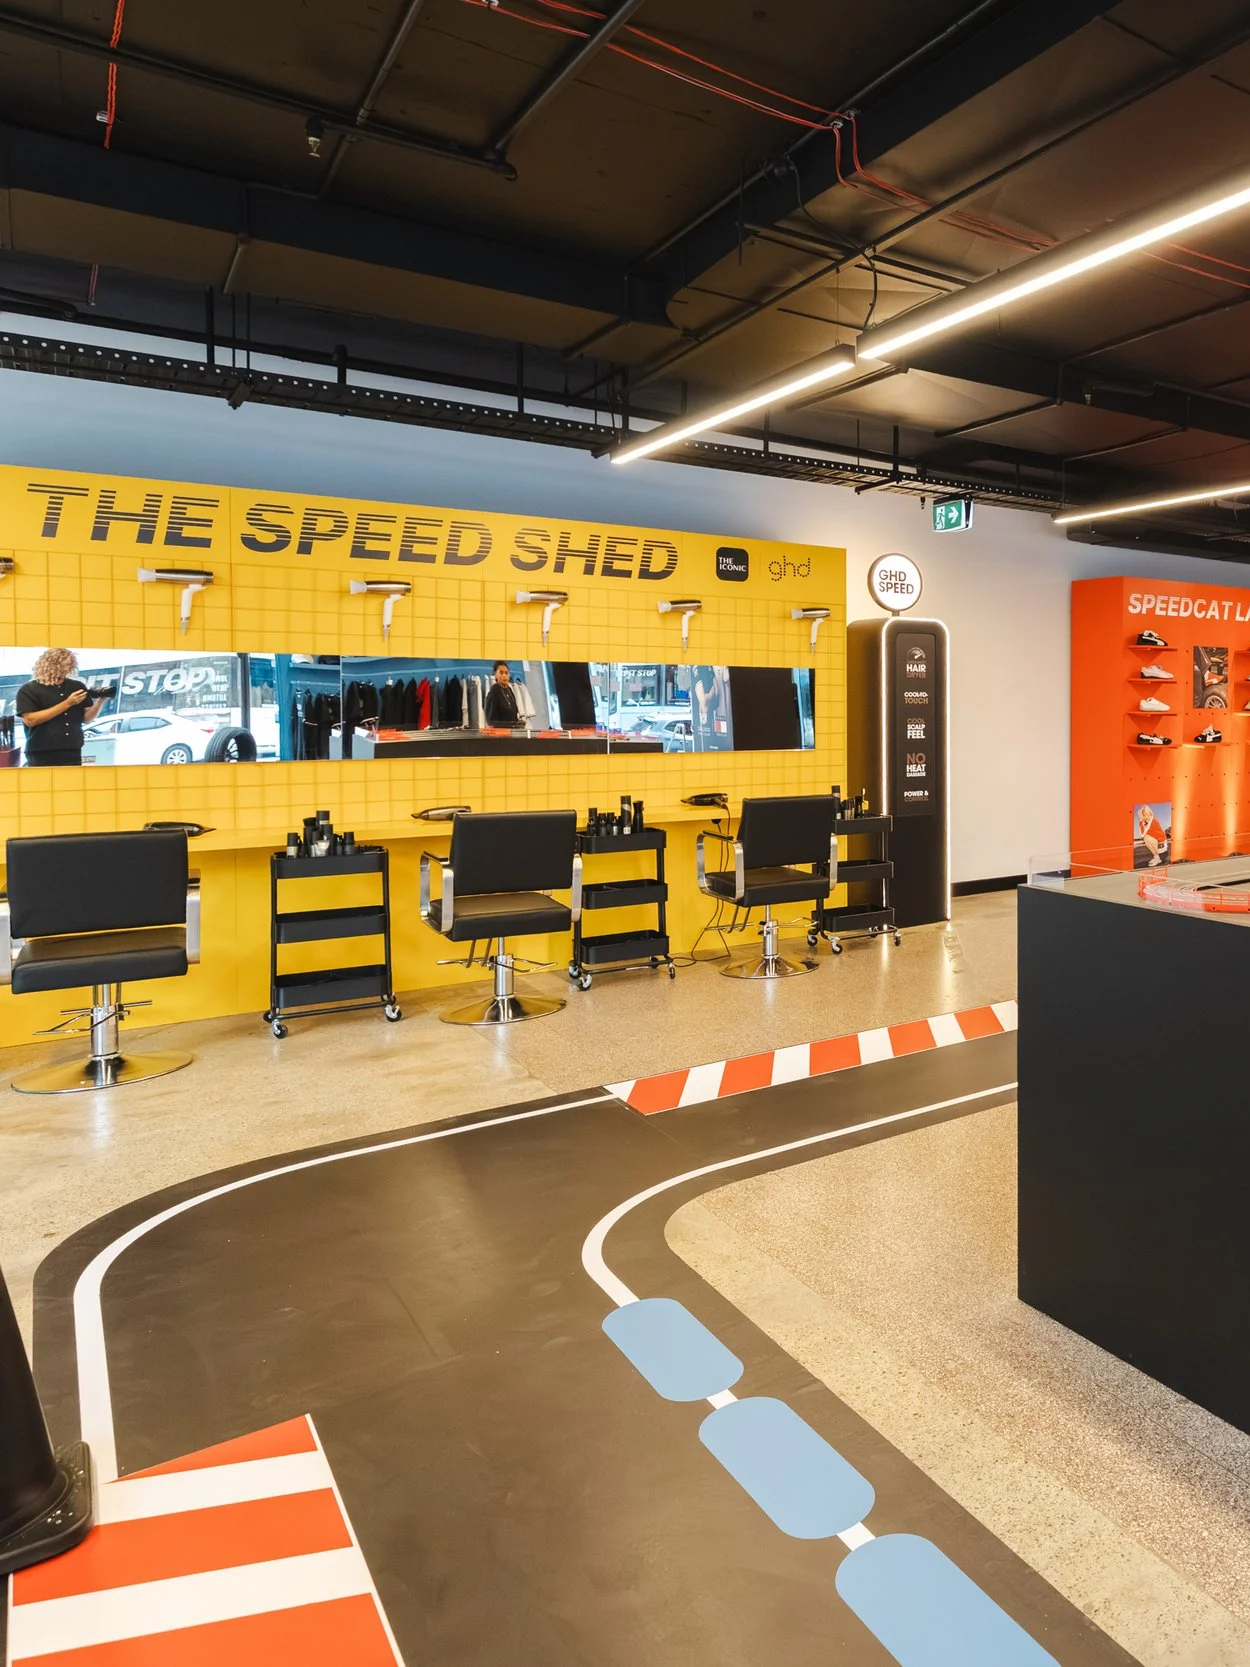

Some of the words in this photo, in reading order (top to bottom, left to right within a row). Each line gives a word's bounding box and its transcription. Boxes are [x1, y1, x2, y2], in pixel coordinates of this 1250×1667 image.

[27, 483, 220, 548] THE
[240, 503, 493, 566] SPEED
[509, 528, 678, 581] SHED
[719, 563, 747, 572] ICONIC
[768, 555, 810, 581] ghd
[879, 569, 906, 582] GHD
[879, 581, 914, 594] SPEED
[1128, 593, 1233, 621] SPEEDCAT
[906, 664, 926, 672] HAIR
[121, 667, 214, 695] STOP
[907, 730, 926, 739] FEEL
[906, 753, 926, 764] NO
[906, 764, 926, 772] HEAT
